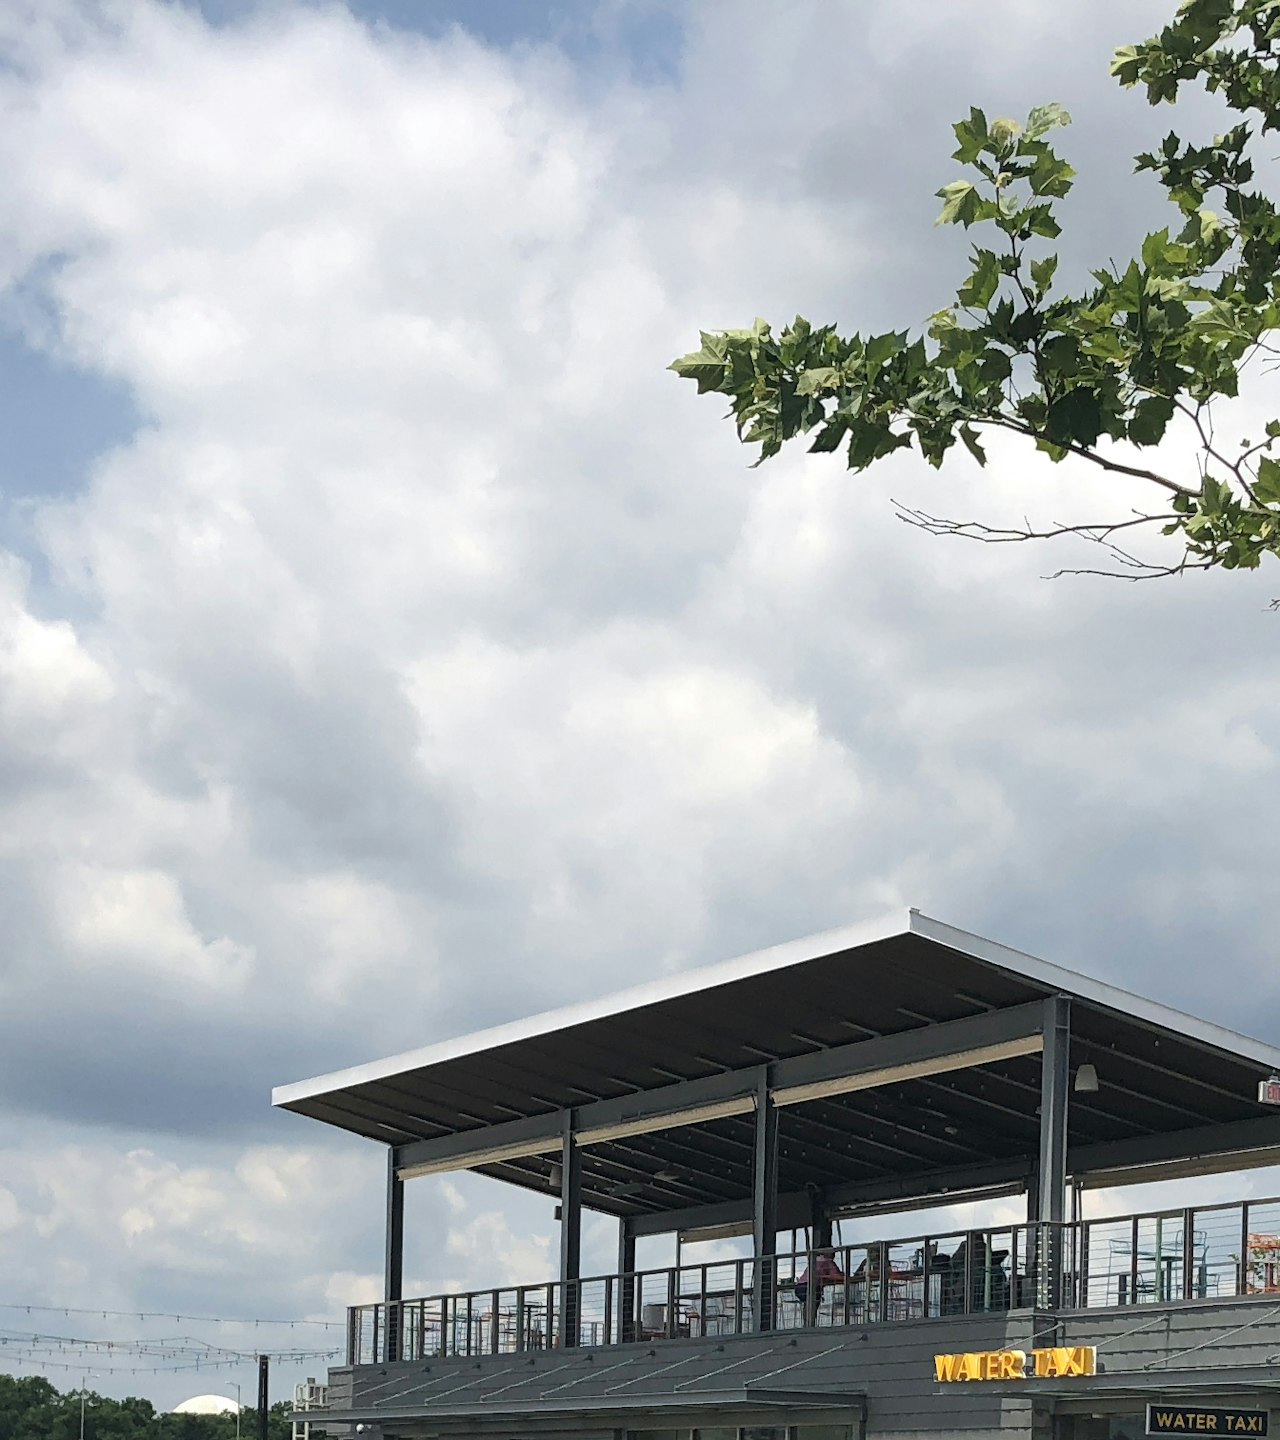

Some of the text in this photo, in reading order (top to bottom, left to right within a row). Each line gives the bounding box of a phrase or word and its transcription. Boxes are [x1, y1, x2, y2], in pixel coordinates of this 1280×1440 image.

[934, 1346, 1093, 1381] WATER TAXI
[1156, 1412, 1263, 1432] WATER TAXI
